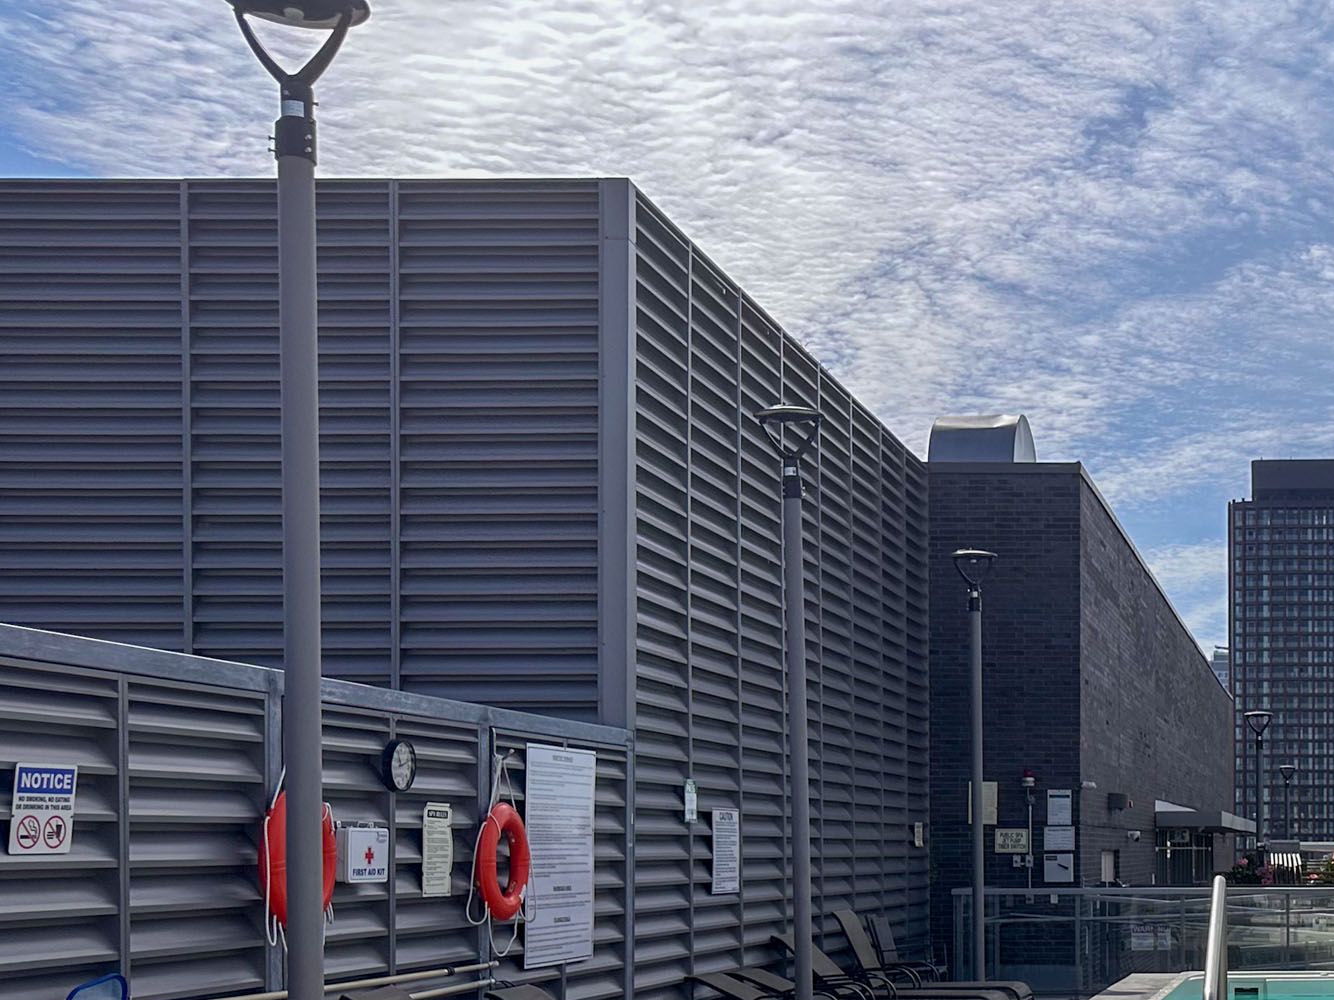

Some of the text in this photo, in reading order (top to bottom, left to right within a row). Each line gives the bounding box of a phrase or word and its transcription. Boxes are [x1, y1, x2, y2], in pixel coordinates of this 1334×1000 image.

[20, 772, 73, 789] NOTICE
[352, 868, 385, 876] FIRST AID KIT
